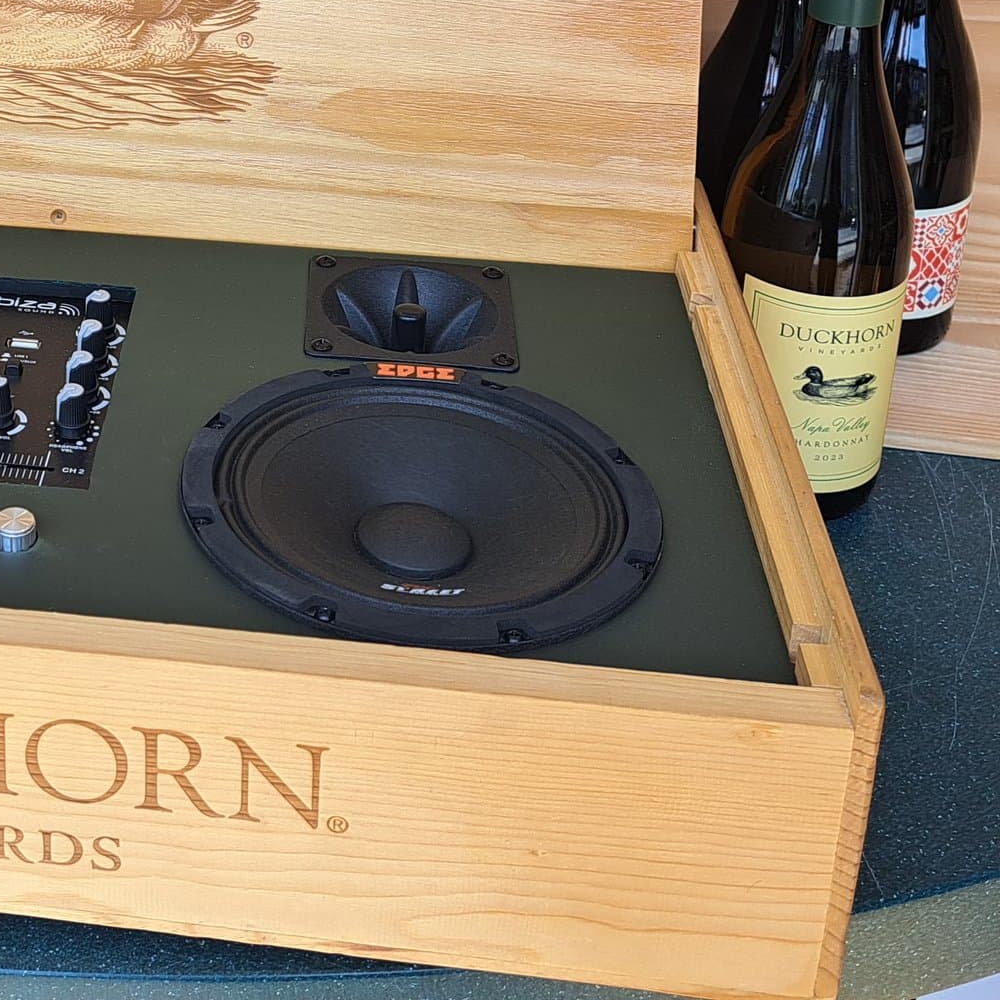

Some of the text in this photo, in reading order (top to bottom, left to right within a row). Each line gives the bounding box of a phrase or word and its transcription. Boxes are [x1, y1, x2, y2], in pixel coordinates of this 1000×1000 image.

[778, 319, 896, 345] DUCKHORN
[798, 343, 882, 355] VINEYARDS
[791, 415, 871, 436] Napa Valley
[813, 453, 845, 462] 2023
[61, 466, 86, 475] CH 2
